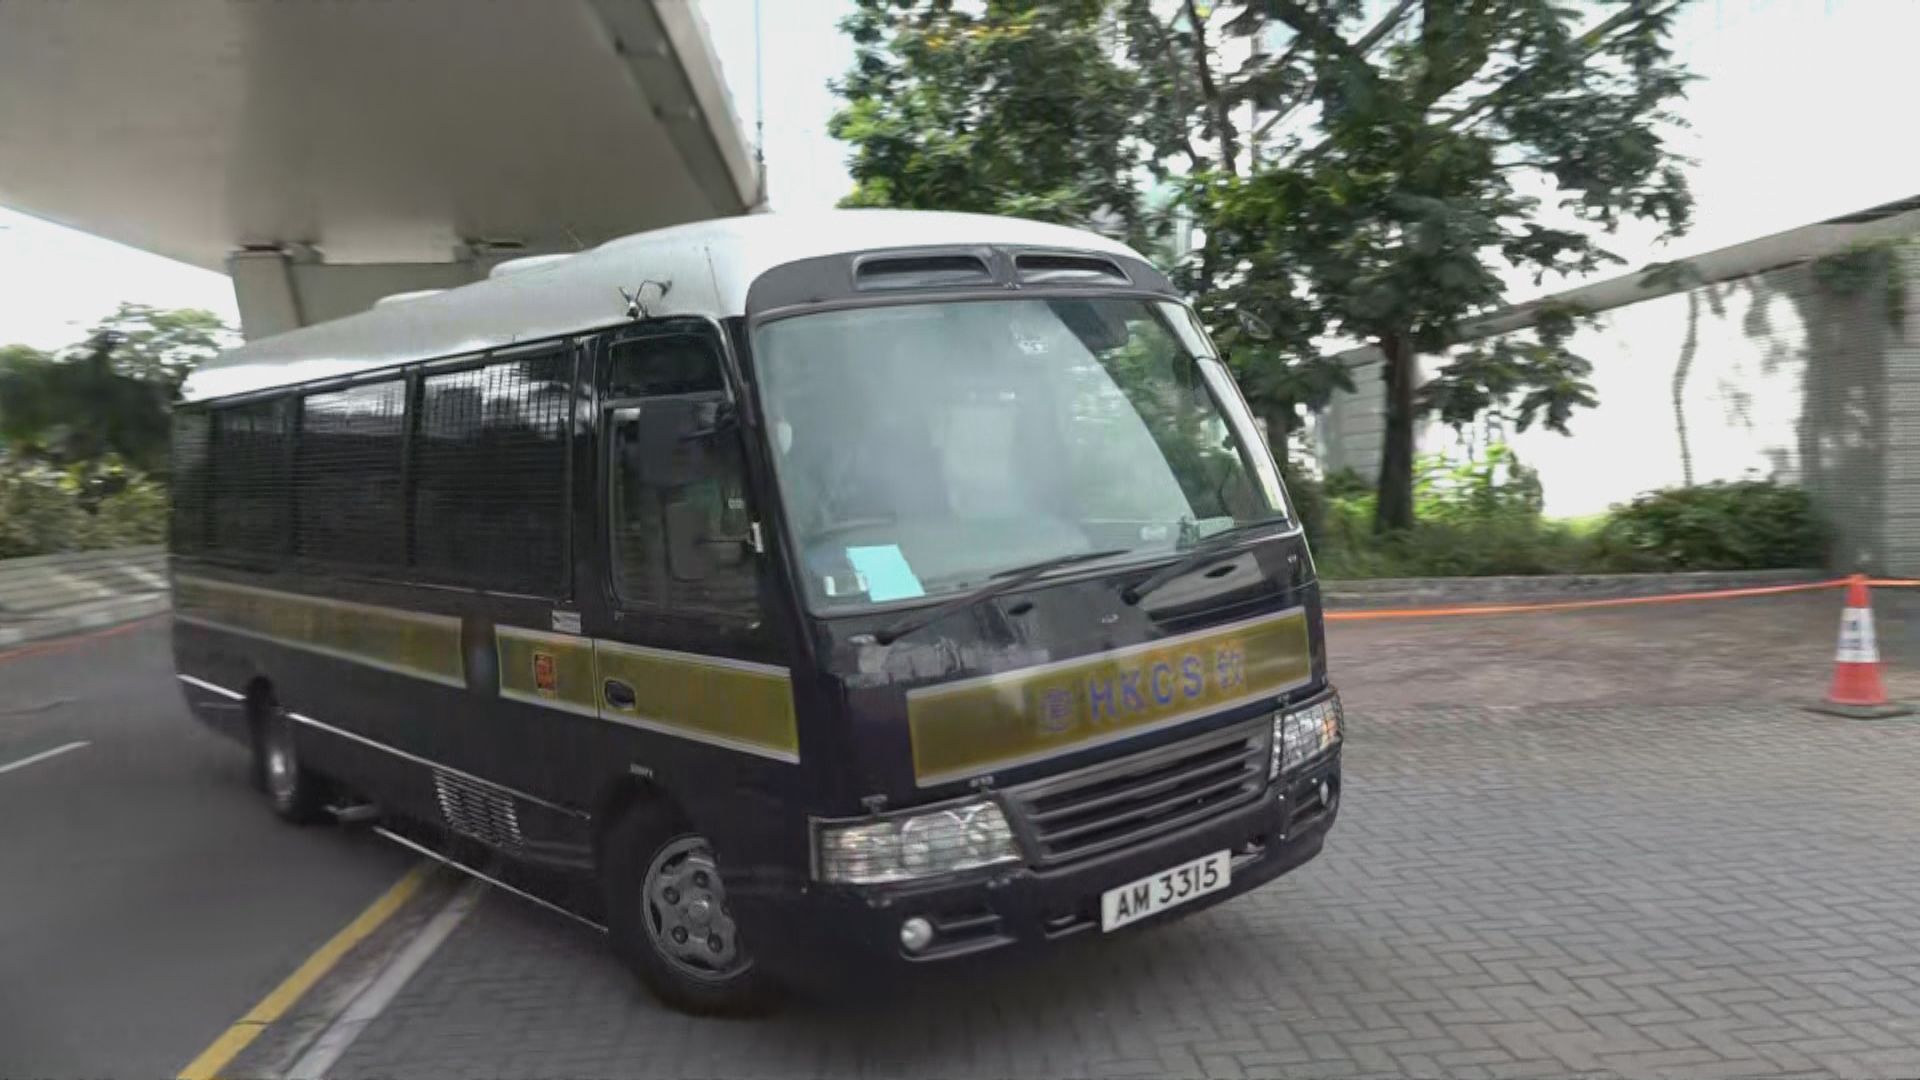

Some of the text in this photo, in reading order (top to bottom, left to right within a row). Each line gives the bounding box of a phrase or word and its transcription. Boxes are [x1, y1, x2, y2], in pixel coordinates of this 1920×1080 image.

[1089, 656, 1203, 720] HKCS
[1116, 858, 1218, 921] AM 3315
